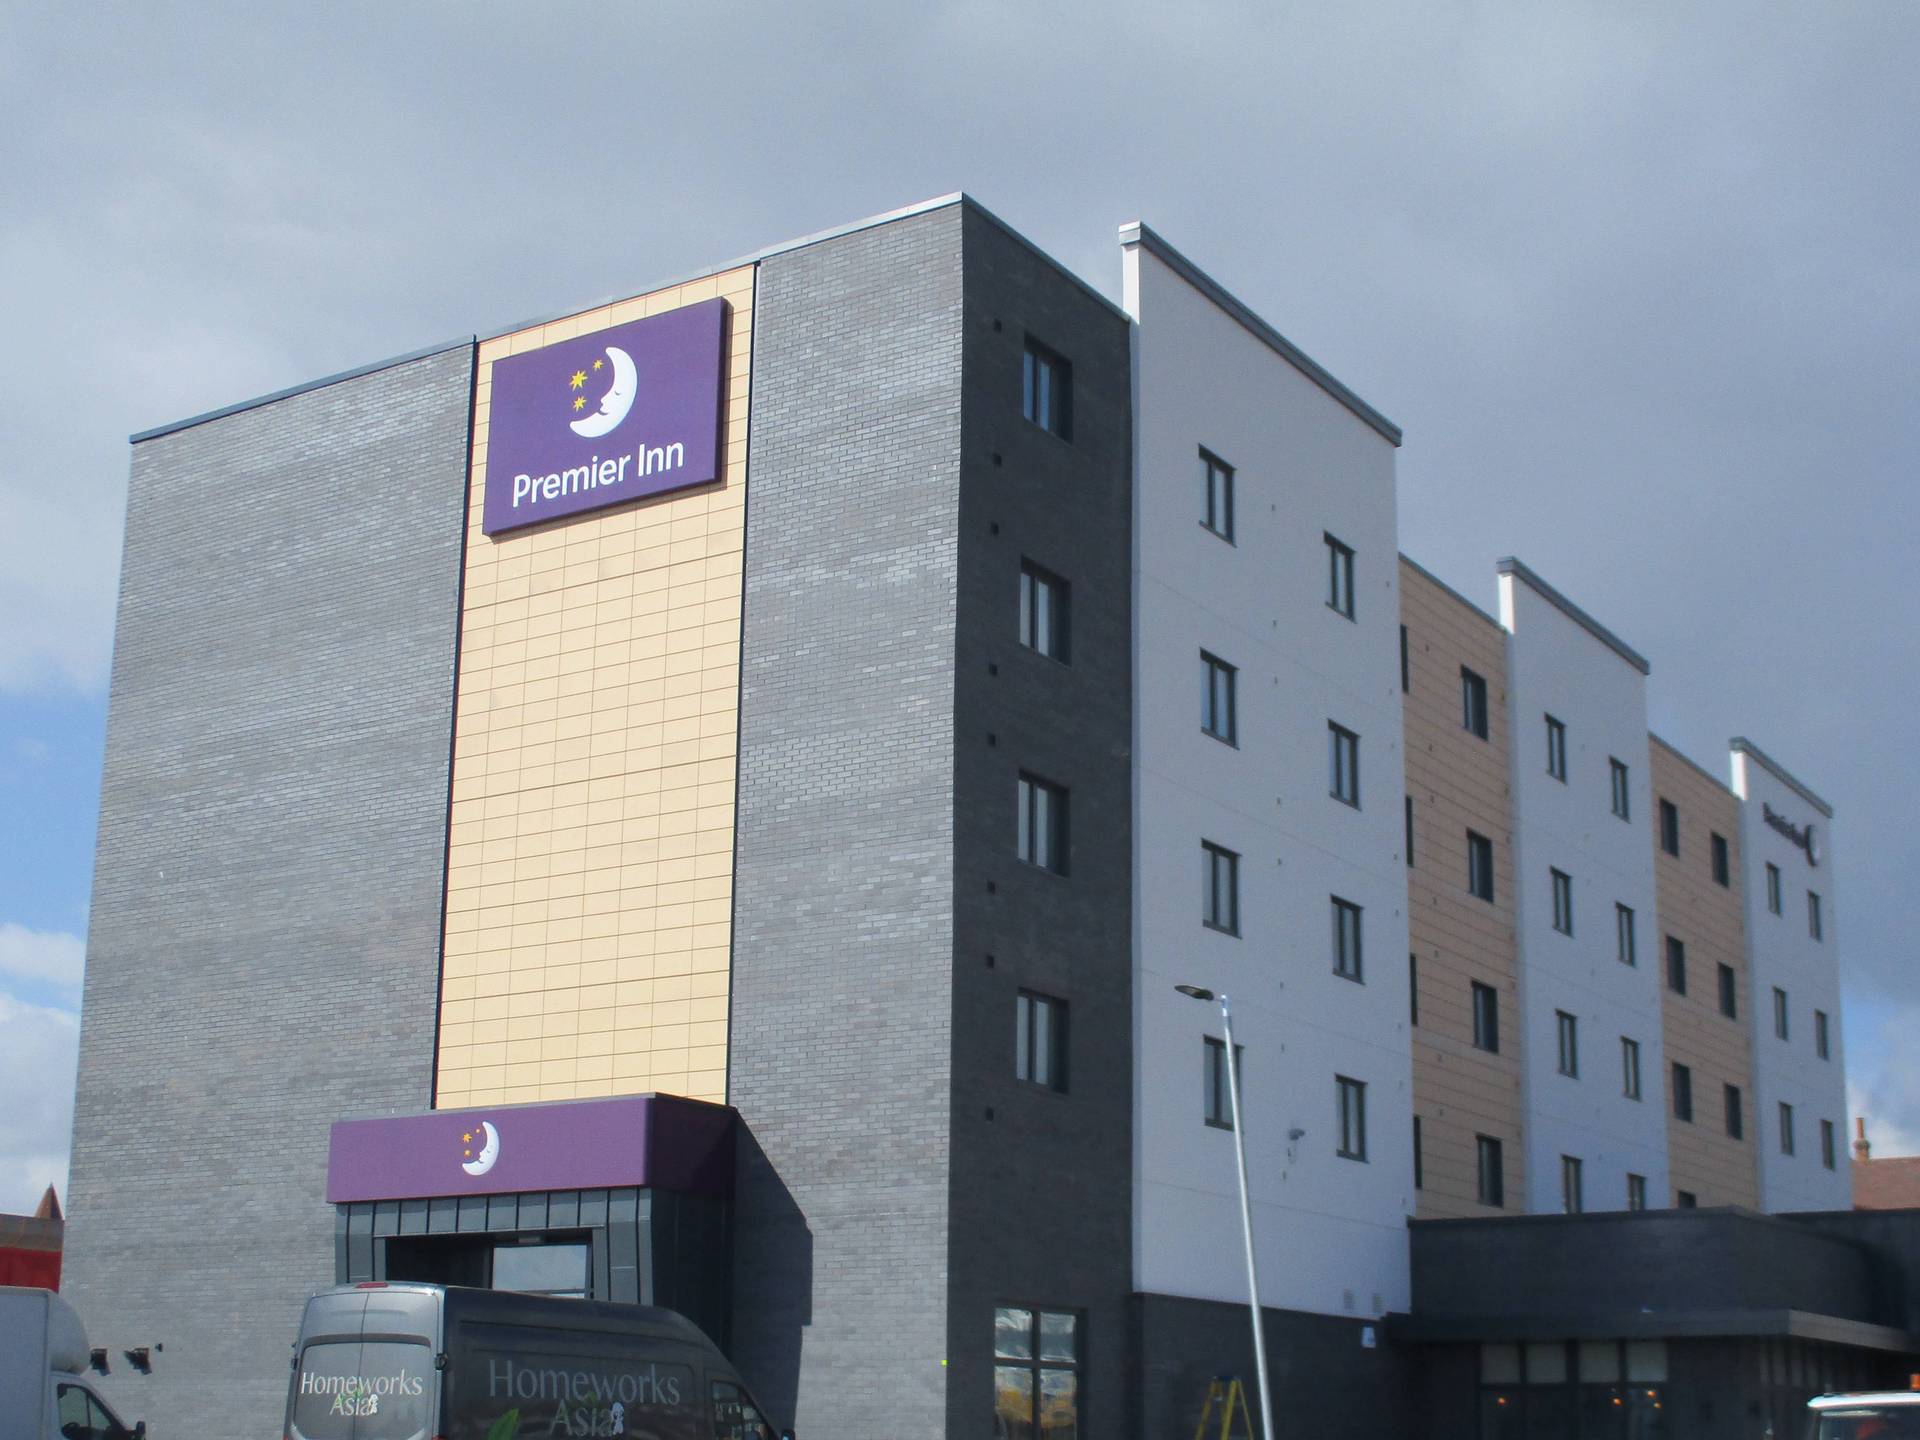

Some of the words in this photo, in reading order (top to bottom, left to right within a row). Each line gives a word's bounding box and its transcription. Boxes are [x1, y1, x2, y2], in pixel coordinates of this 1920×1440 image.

[512, 455, 631, 508] Premier
[638, 442, 684, 477] Inn
[300, 1369, 423, 1396] Homeworks
[489, 1359, 681, 1406] Homeworks
[329, 1393, 372, 1416] Asia
[550, 1399, 614, 1438] Asia
